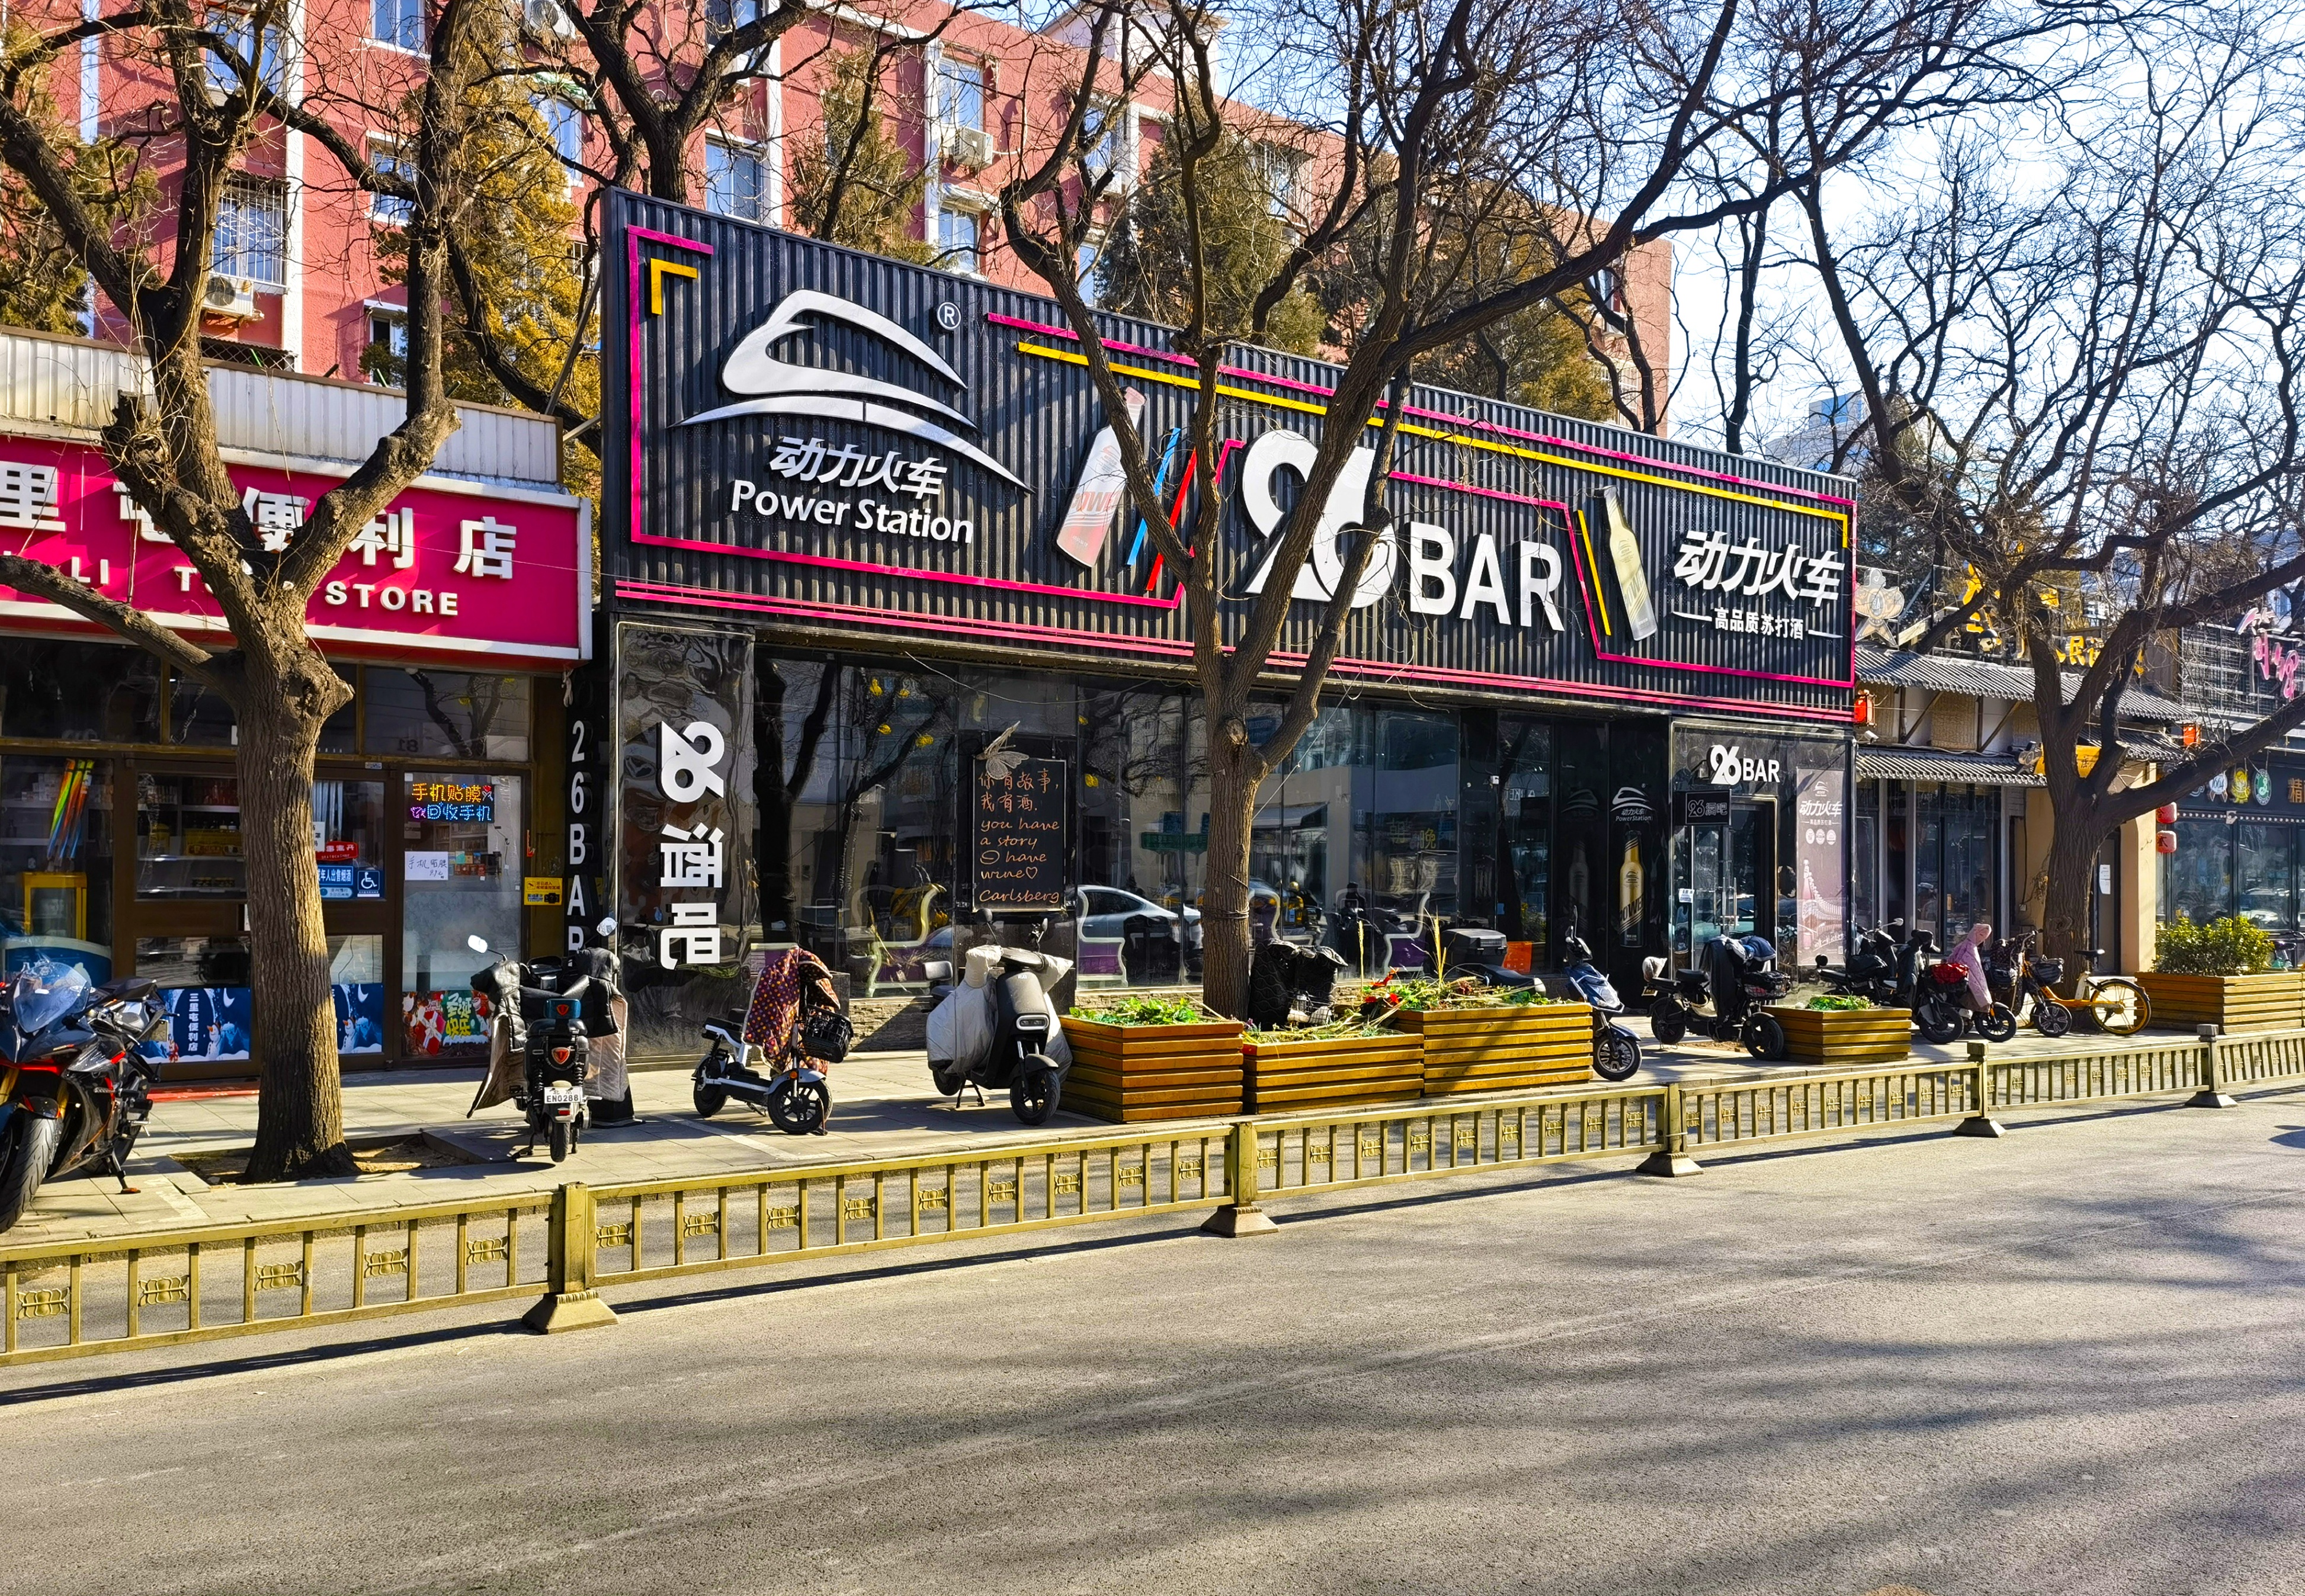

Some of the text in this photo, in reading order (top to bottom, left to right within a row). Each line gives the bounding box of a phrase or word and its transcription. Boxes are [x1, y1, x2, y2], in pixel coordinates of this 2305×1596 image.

[770, 437, 948, 499] 动力火车
[731, 479, 973, 544] Power Station
[1408, 521, 1565, 632] BAR
[1674, 530, 1845, 607] 动力火车
[324, 580, 459, 616] STORE
[1714, 607, 1804, 640] 高品质苏打酒
[1743, 758, 1781, 783] BAR
[411, 783, 482, 803] 手机贴膜
[2288, 778, 2305, 803] 精
[427, 803, 492, 822] 回收手机
[1799, 800, 1843, 818] 动力火车
[980, 818, 1060, 833] you have
[980, 835, 1038, 851] a story
[1005, 851, 1047, 863] have
[979, 888, 1060, 904] Carlsberg
[188, 993, 199, 1052] 三里屯便利店
